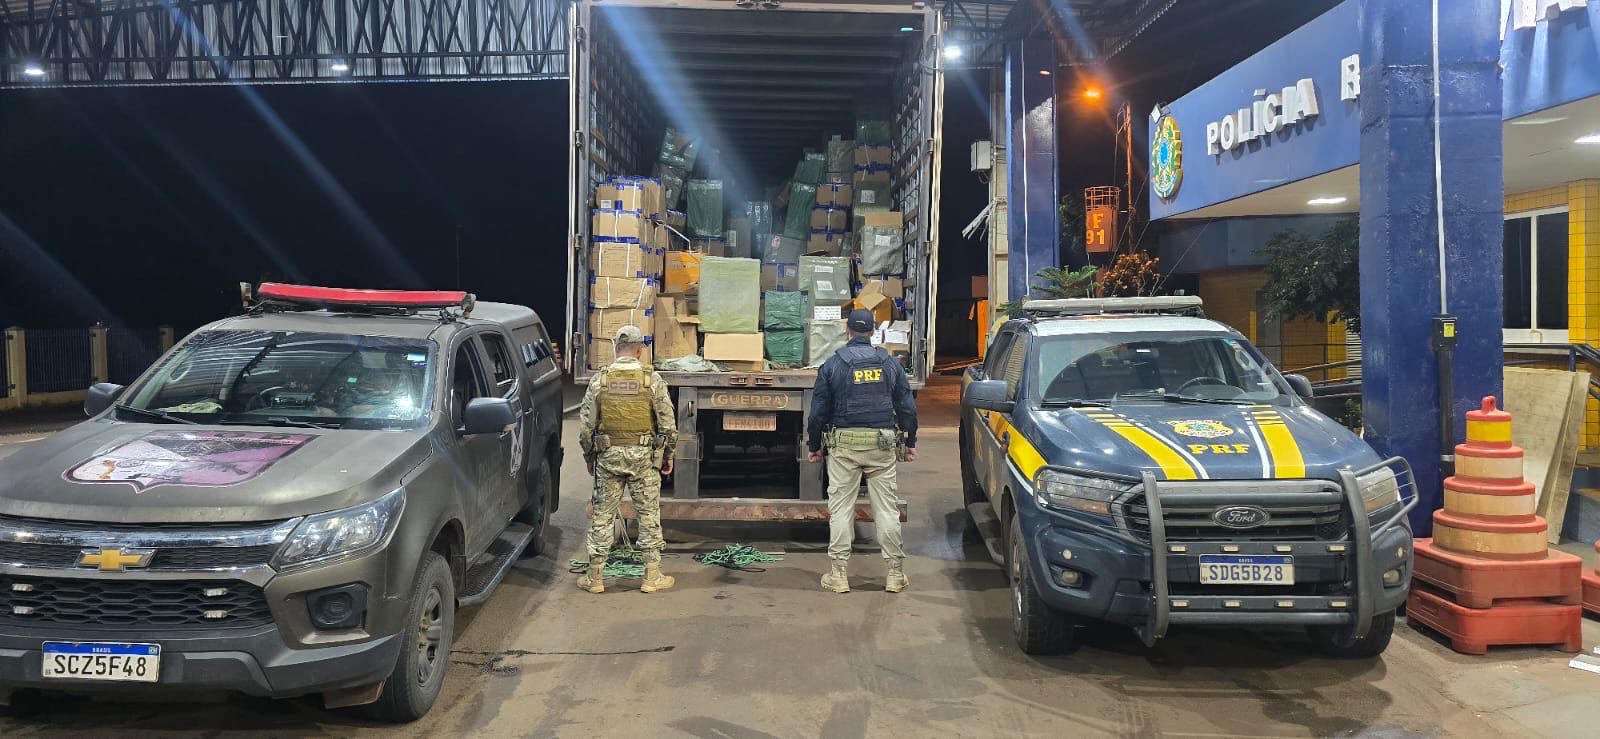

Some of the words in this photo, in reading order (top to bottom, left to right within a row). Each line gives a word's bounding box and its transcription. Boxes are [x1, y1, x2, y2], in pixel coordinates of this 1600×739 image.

[1206, 78, 1319, 155] POLÍCIA
[854, 369, 882, 384] PRF
[717, 394, 783, 405] GUERRA
[1188, 444, 1250, 454] PRF
[1227, 510, 1256, 522] Ford
[1209, 565, 1283, 581] SDG5B28
[54, 655, 146, 677] SCZ5F48
